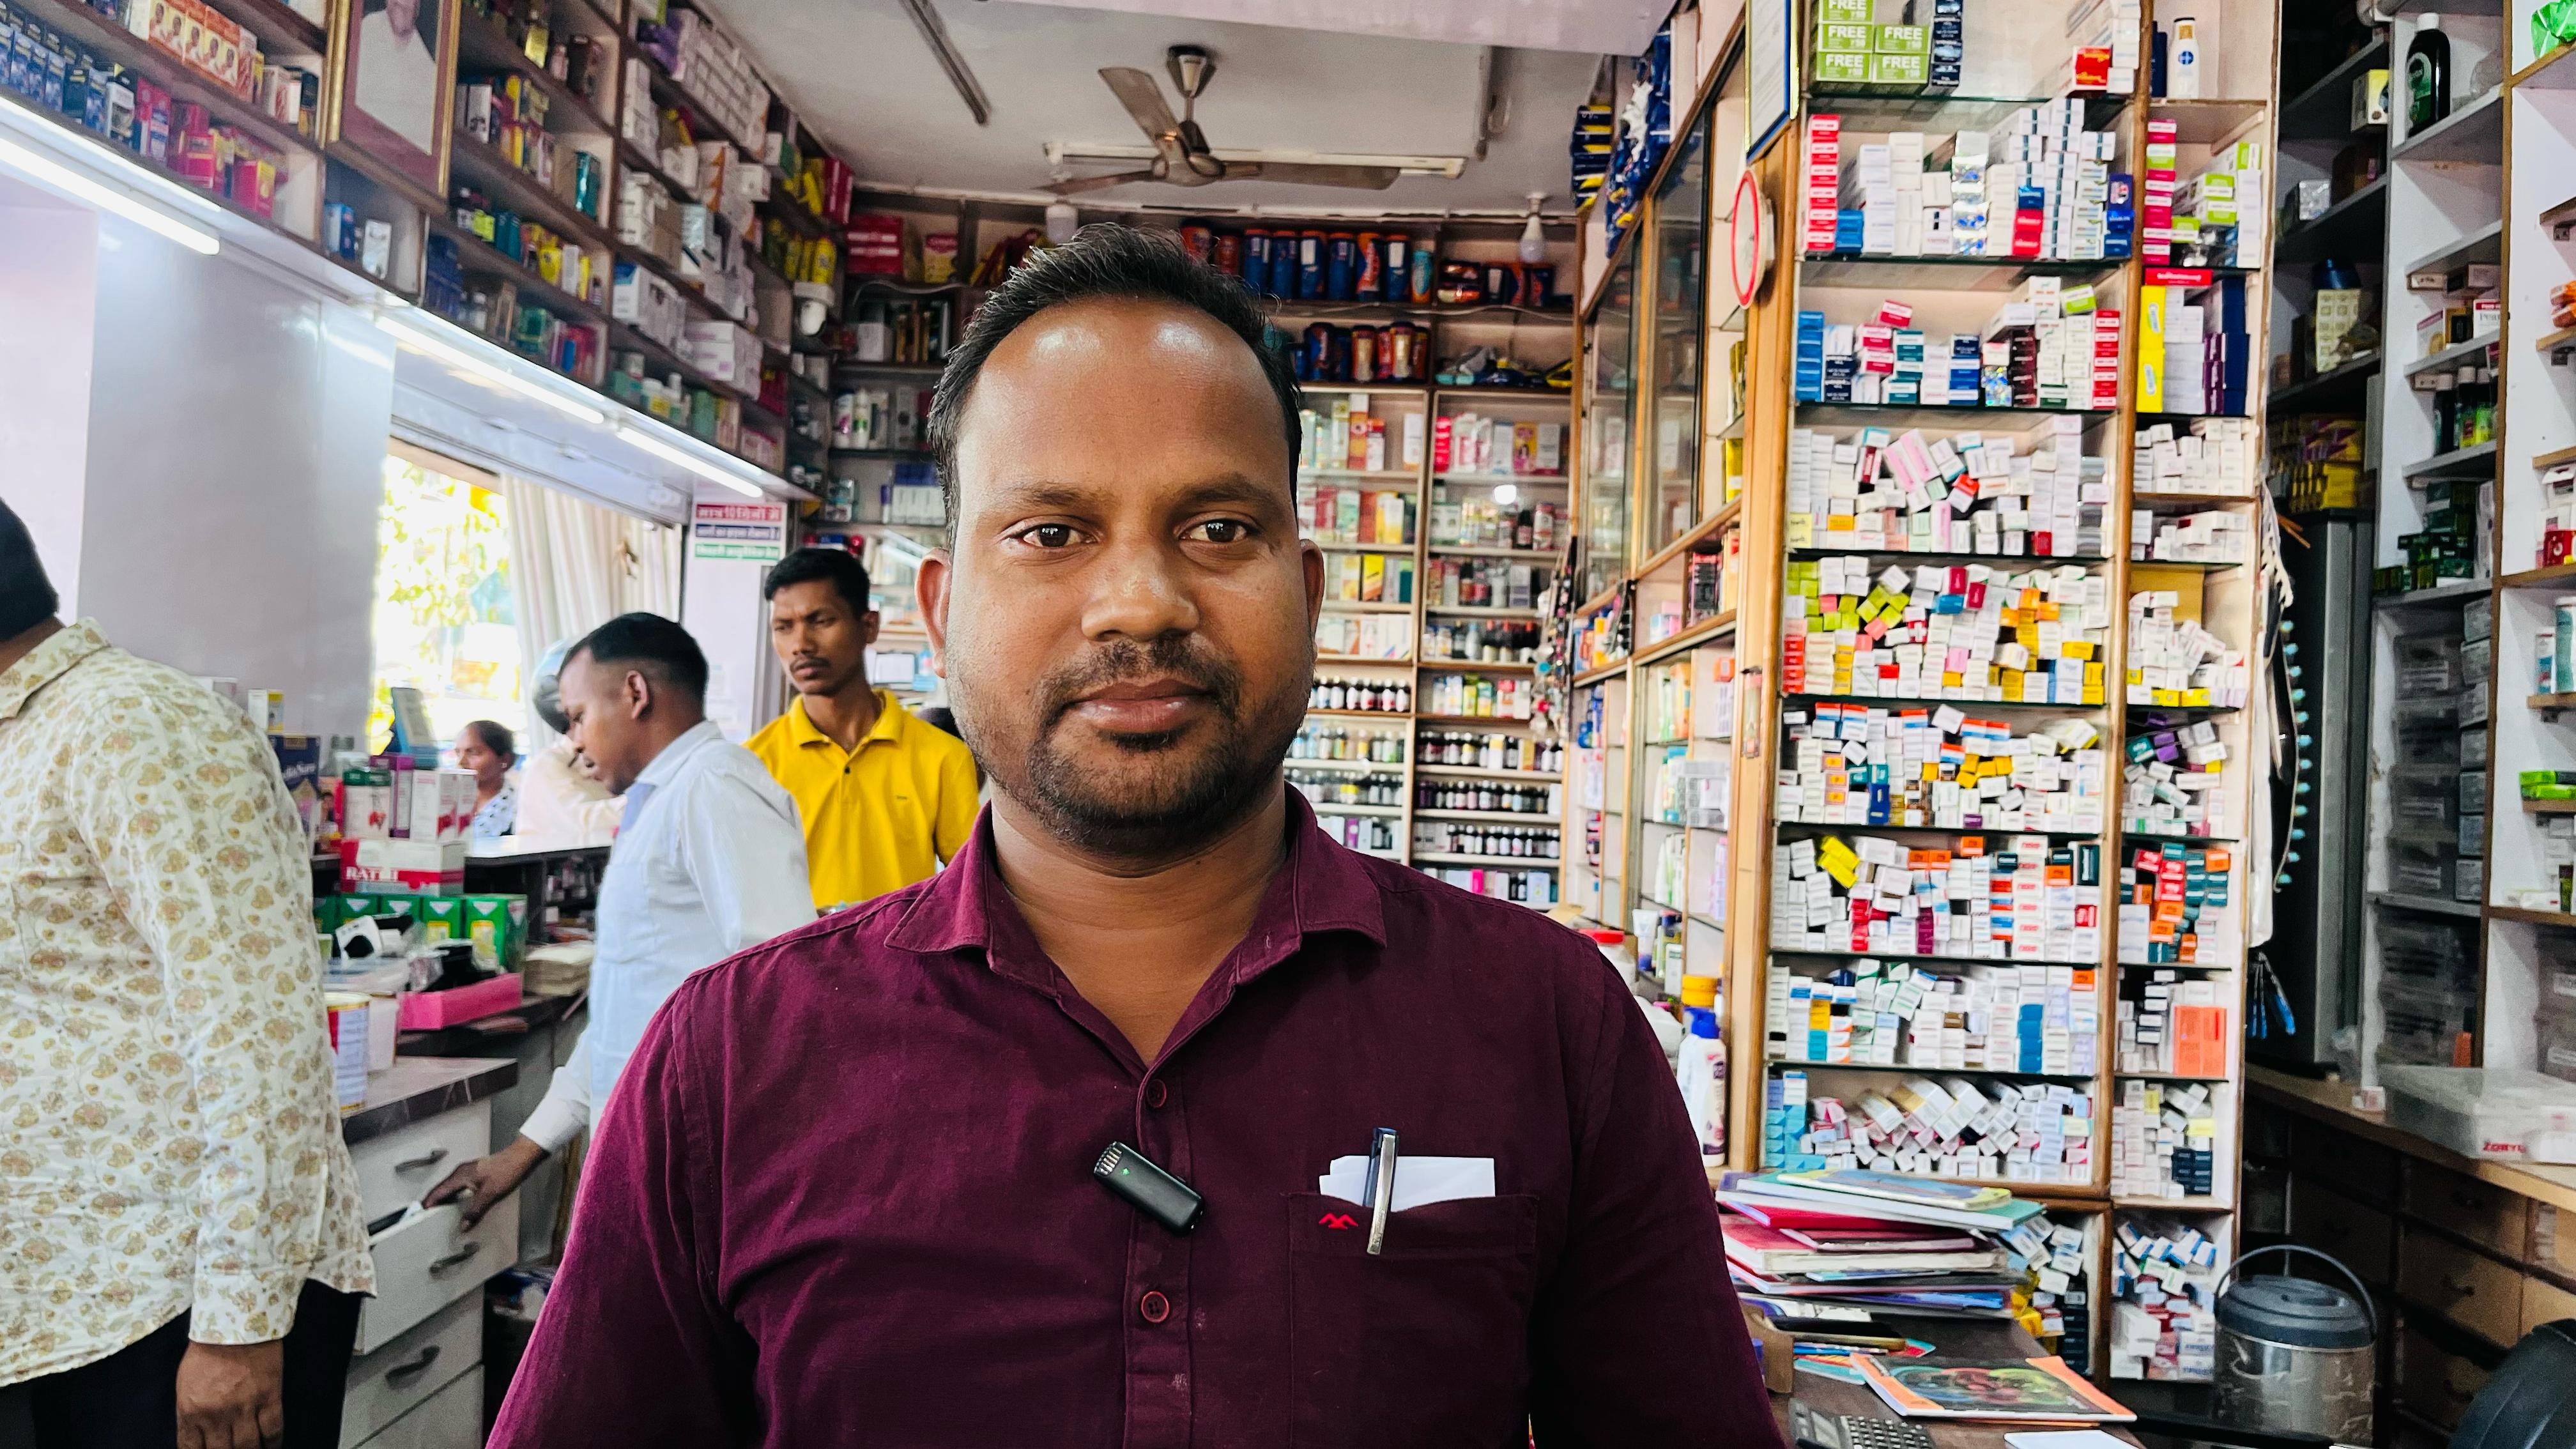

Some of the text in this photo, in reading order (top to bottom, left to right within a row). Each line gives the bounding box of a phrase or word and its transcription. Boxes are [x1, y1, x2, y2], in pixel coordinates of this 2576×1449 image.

[1828, 0, 1866, 10] FREE
[1828, 25, 1866, 38] FREE
[1885, 26, 1923, 40] FREE
[1825, 54, 1864, 67] FREE
[1882, 56, 1920, 69] FREE
